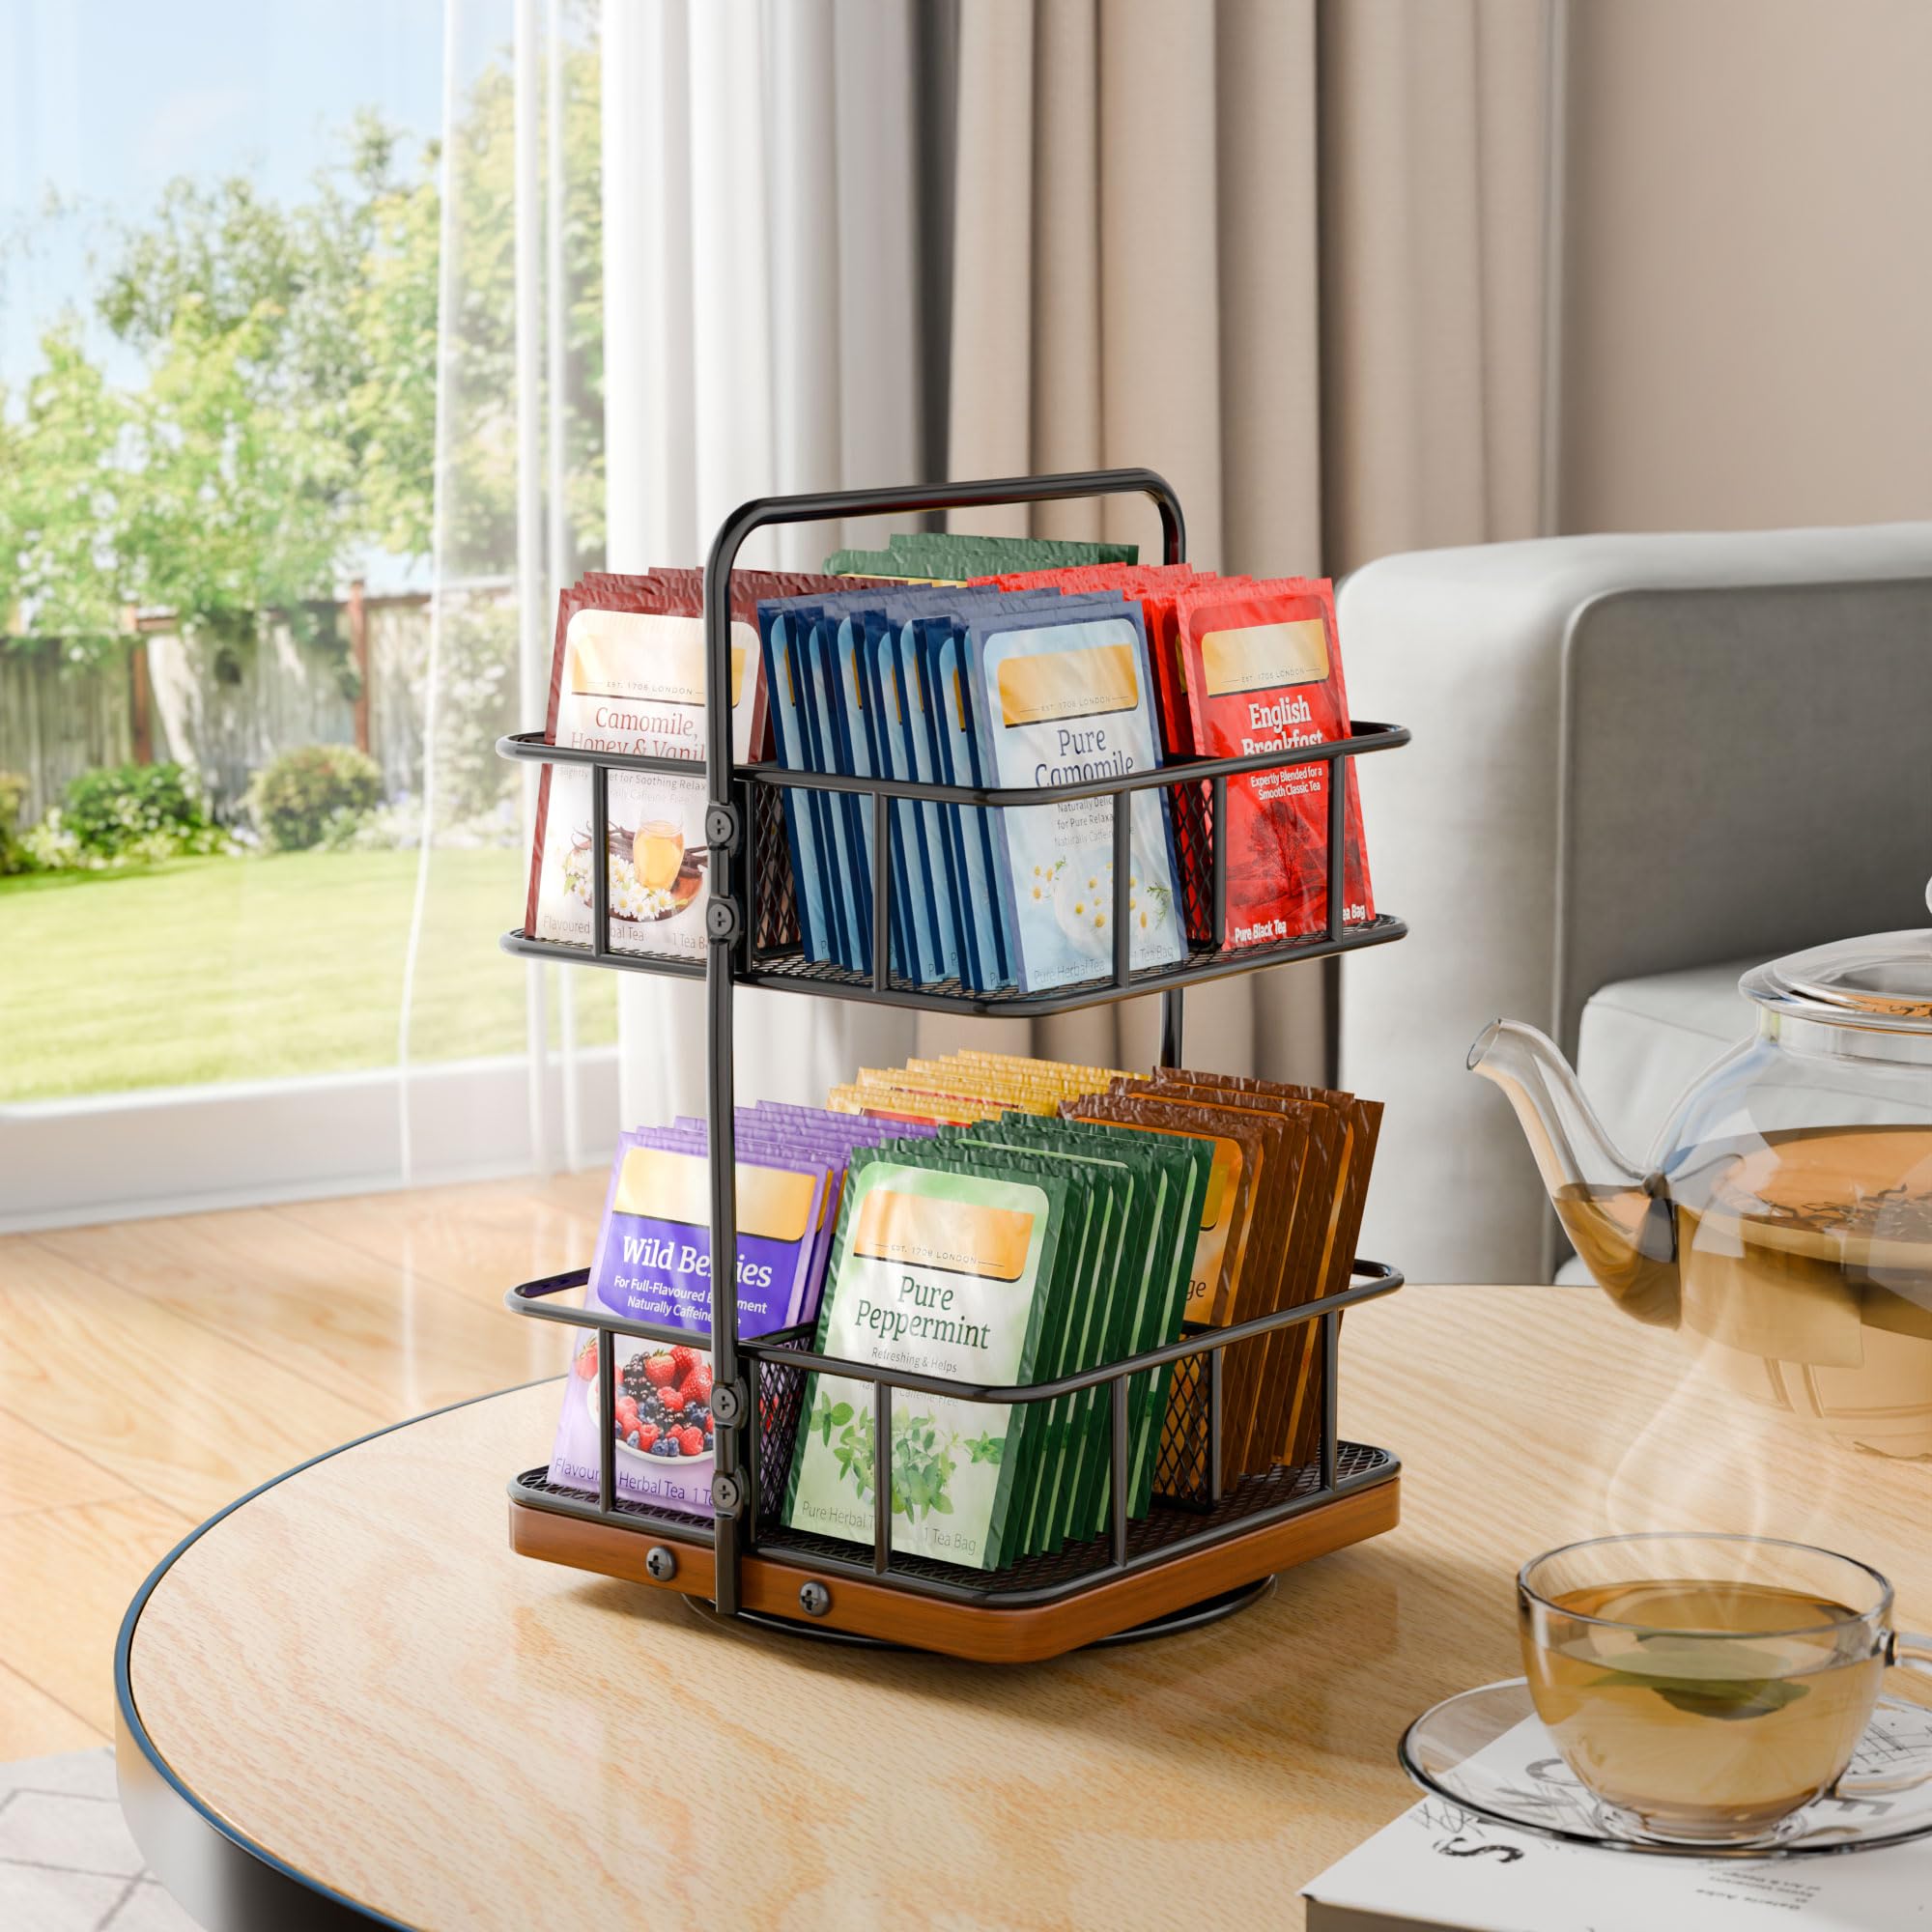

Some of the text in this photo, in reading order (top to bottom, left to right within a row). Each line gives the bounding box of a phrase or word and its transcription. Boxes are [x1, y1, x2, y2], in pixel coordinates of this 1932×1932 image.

[596, 706, 698, 740] Camomile,
[1248, 695, 1312, 733] English
[633, 738, 647, 756] &
[653, 739, 705, 761] Vanil
[1057, 728, 1107, 757] Pure
[621, 773, 634, 784] for
[635, 773, 677, 790] Soothing
[1250, 766, 1322, 789] Expertly Blended for a
[1259, 780, 1321, 801] Smooth Classic Tea
[1058, 796, 1114, 814] Naturally Delic
[1057, 813, 1114, 831] for Pure Relaxa
[1351, 903, 1366, 920] Bag
[543, 915, 590, 933] Flavoured
[628, 926, 644, 942] Tea
[680, 935, 696, 949] Tea
[1235, 919, 1288, 944] Pure Black Tea
[622, 1235, 773, 1289] Wild Beies
[936, 1251, 978, 1265] LONDON
[613, 1274, 631, 1290] For
[630, 1277, 706, 1305] Full-Flavoured
[897, 1275, 954, 1311] Pure
[627, 1294, 672, 1318] Naturally
[854, 1298, 991, 1350] Peppermint
[871, 1346, 920, 1369] Refreshing
[921, 1355, 929, 1369] &
[930, 1358, 957, 1374] Helps
[554, 1457, 600, 1482] Flavour
[619, 1470, 662, 1494] Herbal
[664, 1479, 685, 1501] Tea
[694, 1487, 698, 1502] 1
[802, 1500, 827, 1520] Pure
[829, 1507, 866, 1529] Herbal
[932, 1527, 952, 1547] Tea
[954, 1532, 977, 1556] Bag
